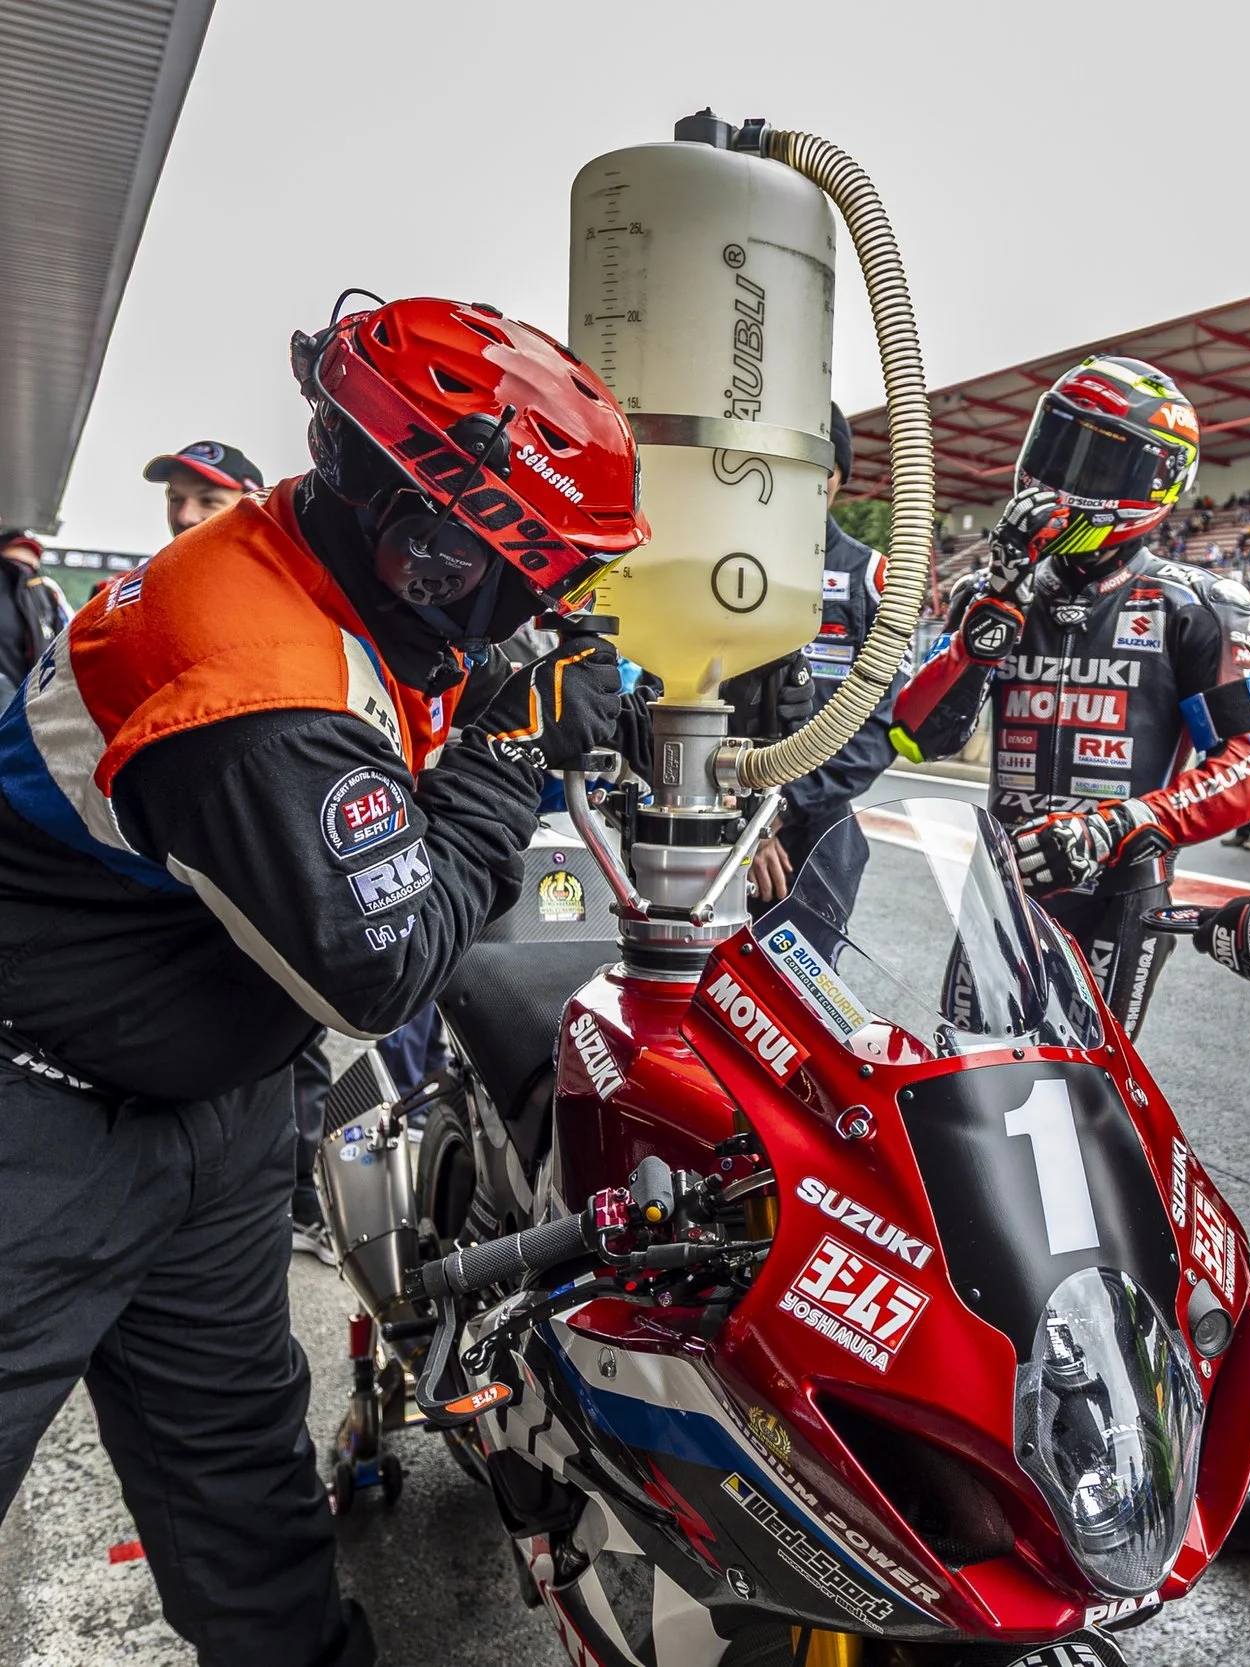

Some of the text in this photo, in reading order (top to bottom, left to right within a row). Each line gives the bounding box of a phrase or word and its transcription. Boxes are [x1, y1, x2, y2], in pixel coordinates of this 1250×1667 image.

[629, 223, 644, 234] 25L
[627, 311, 642, 322] 20L
[627, 398, 641, 409] 15L
[516, 444, 584, 504] Sébastien
[388, 422, 567, 570] 100%
[622, 567, 633, 578] 5L
[1100, 570, 1131, 593] MOTUL
[1117, 636, 1161, 649] SUZUKI
[997, 655, 1141, 688] SUZUKI
[1006, 690, 1120, 725] MOTUL
[1007, 734, 1033, 745] DENSO
[1078, 737, 1127, 760] RK
[1078, 756, 1109, 765] TAKASAGO
[1075, 781, 1115, 792] SECURITEST
[326, 802, 344, 850] YOSHIMURA
[335, 782, 350, 804] SERT
[347, 771, 371, 788] MOTUL
[345, 787, 392, 829] ヨシムラ
[354, 816, 391, 843] SERT
[355, 843, 430, 904] RK
[366, 885, 414, 911] TAKASAGO
[773, 933, 793, 951] as
[1217, 926, 1234, 968] OMP
[785, 955, 852, 1035] CONTROLE TECHNIQUE
[706, 973, 798, 1077] MOTUL
[569, 1012, 624, 1101] SUZUKI
[1004, 1078, 1100, 1256] 1
[1171, 1136, 1188, 1228] SUZUKI
[796, 1176, 934, 1270] SUZUKI
[798, 1242, 922, 1341] ヨシムラ
[778, 1290, 890, 1373] YOSHIMURA
[744, 1490, 893, 1620] WedsSport
[824, 1511, 941, 1604] POWER
[1084, 1590, 1162, 1628] PIAA
